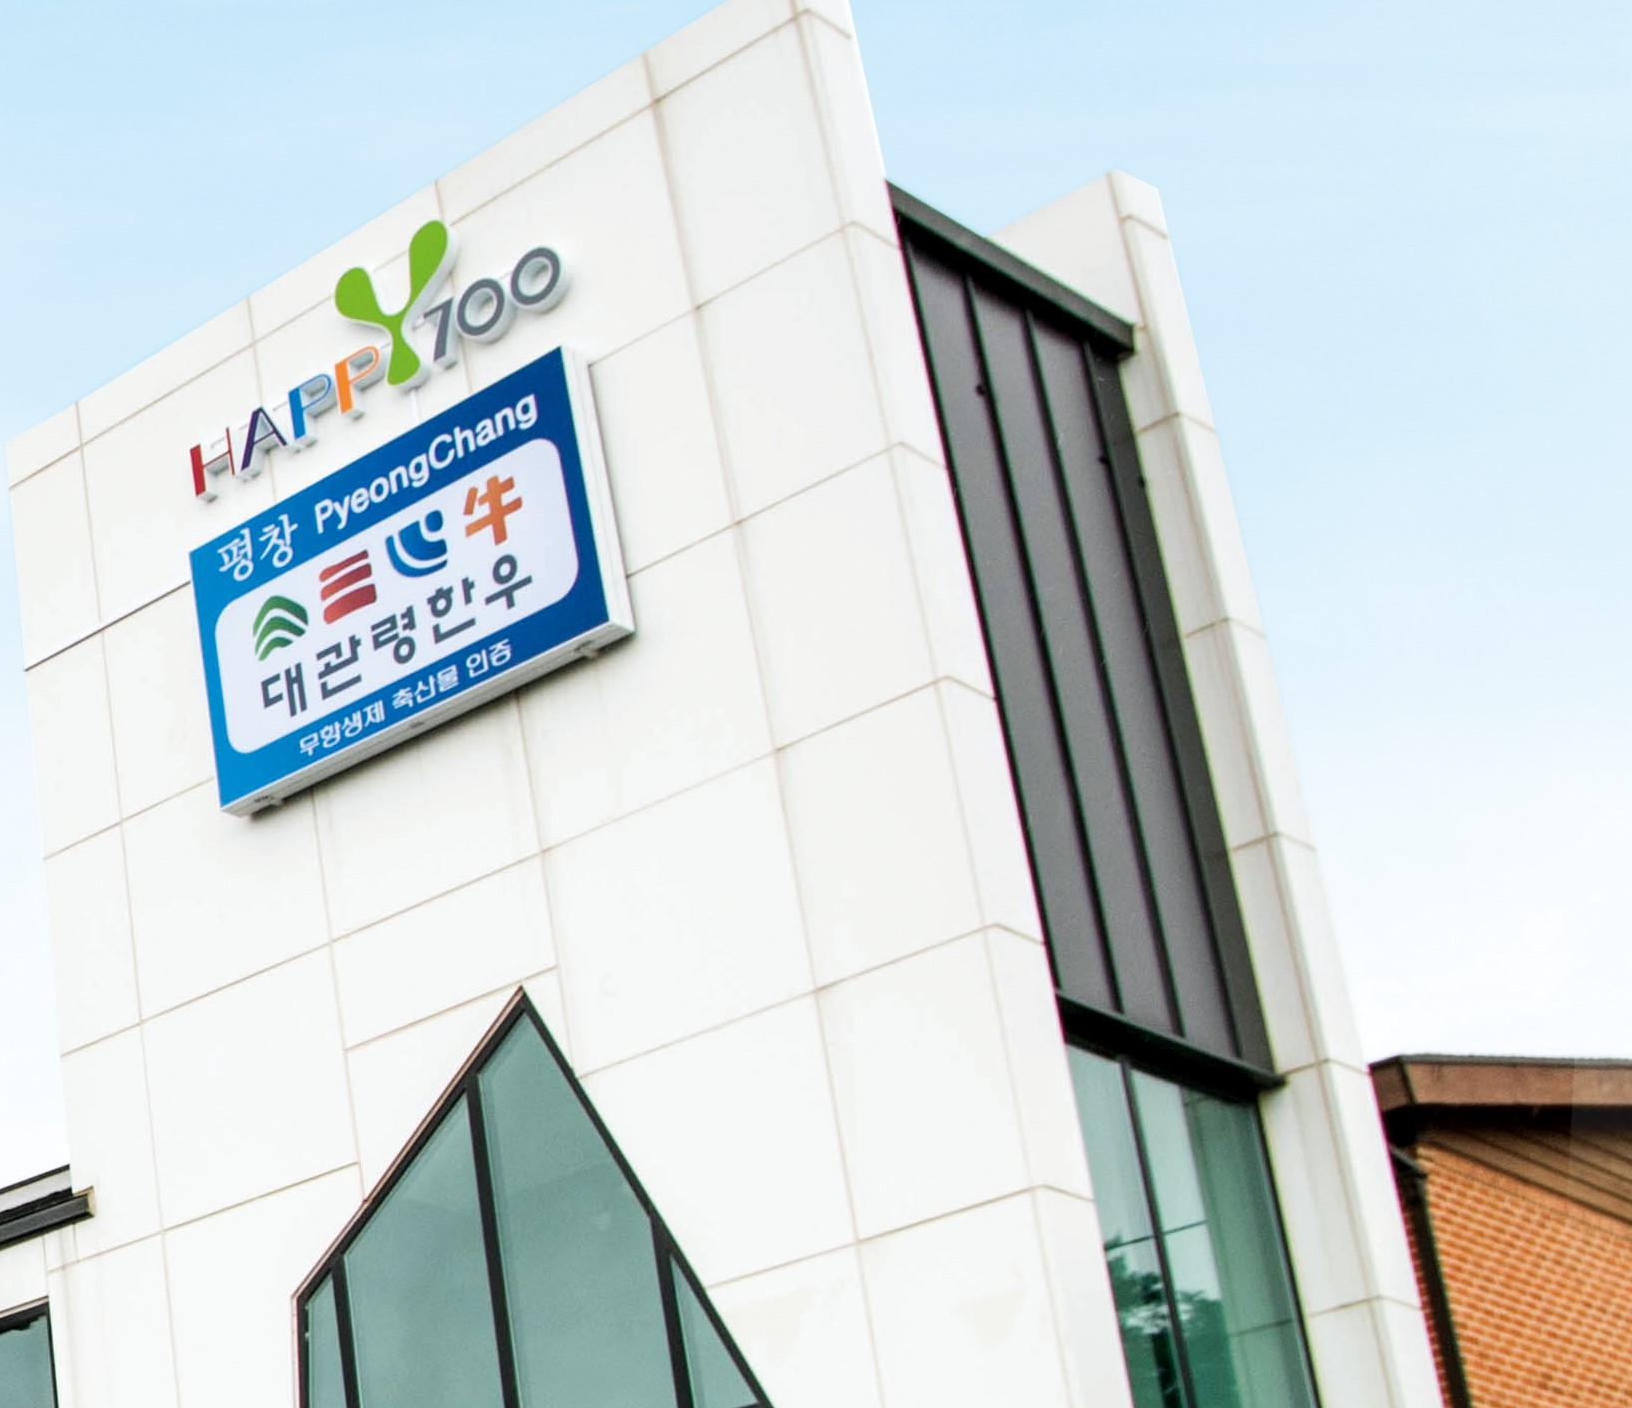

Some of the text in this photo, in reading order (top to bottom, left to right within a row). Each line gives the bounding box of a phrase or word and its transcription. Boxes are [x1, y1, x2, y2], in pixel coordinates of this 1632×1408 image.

[217, 392, 539, 581] 평창 PyeongChang
[261, 554, 533, 717] 대관령한우
[299, 639, 513, 756] 무항생제 축산물 인증
